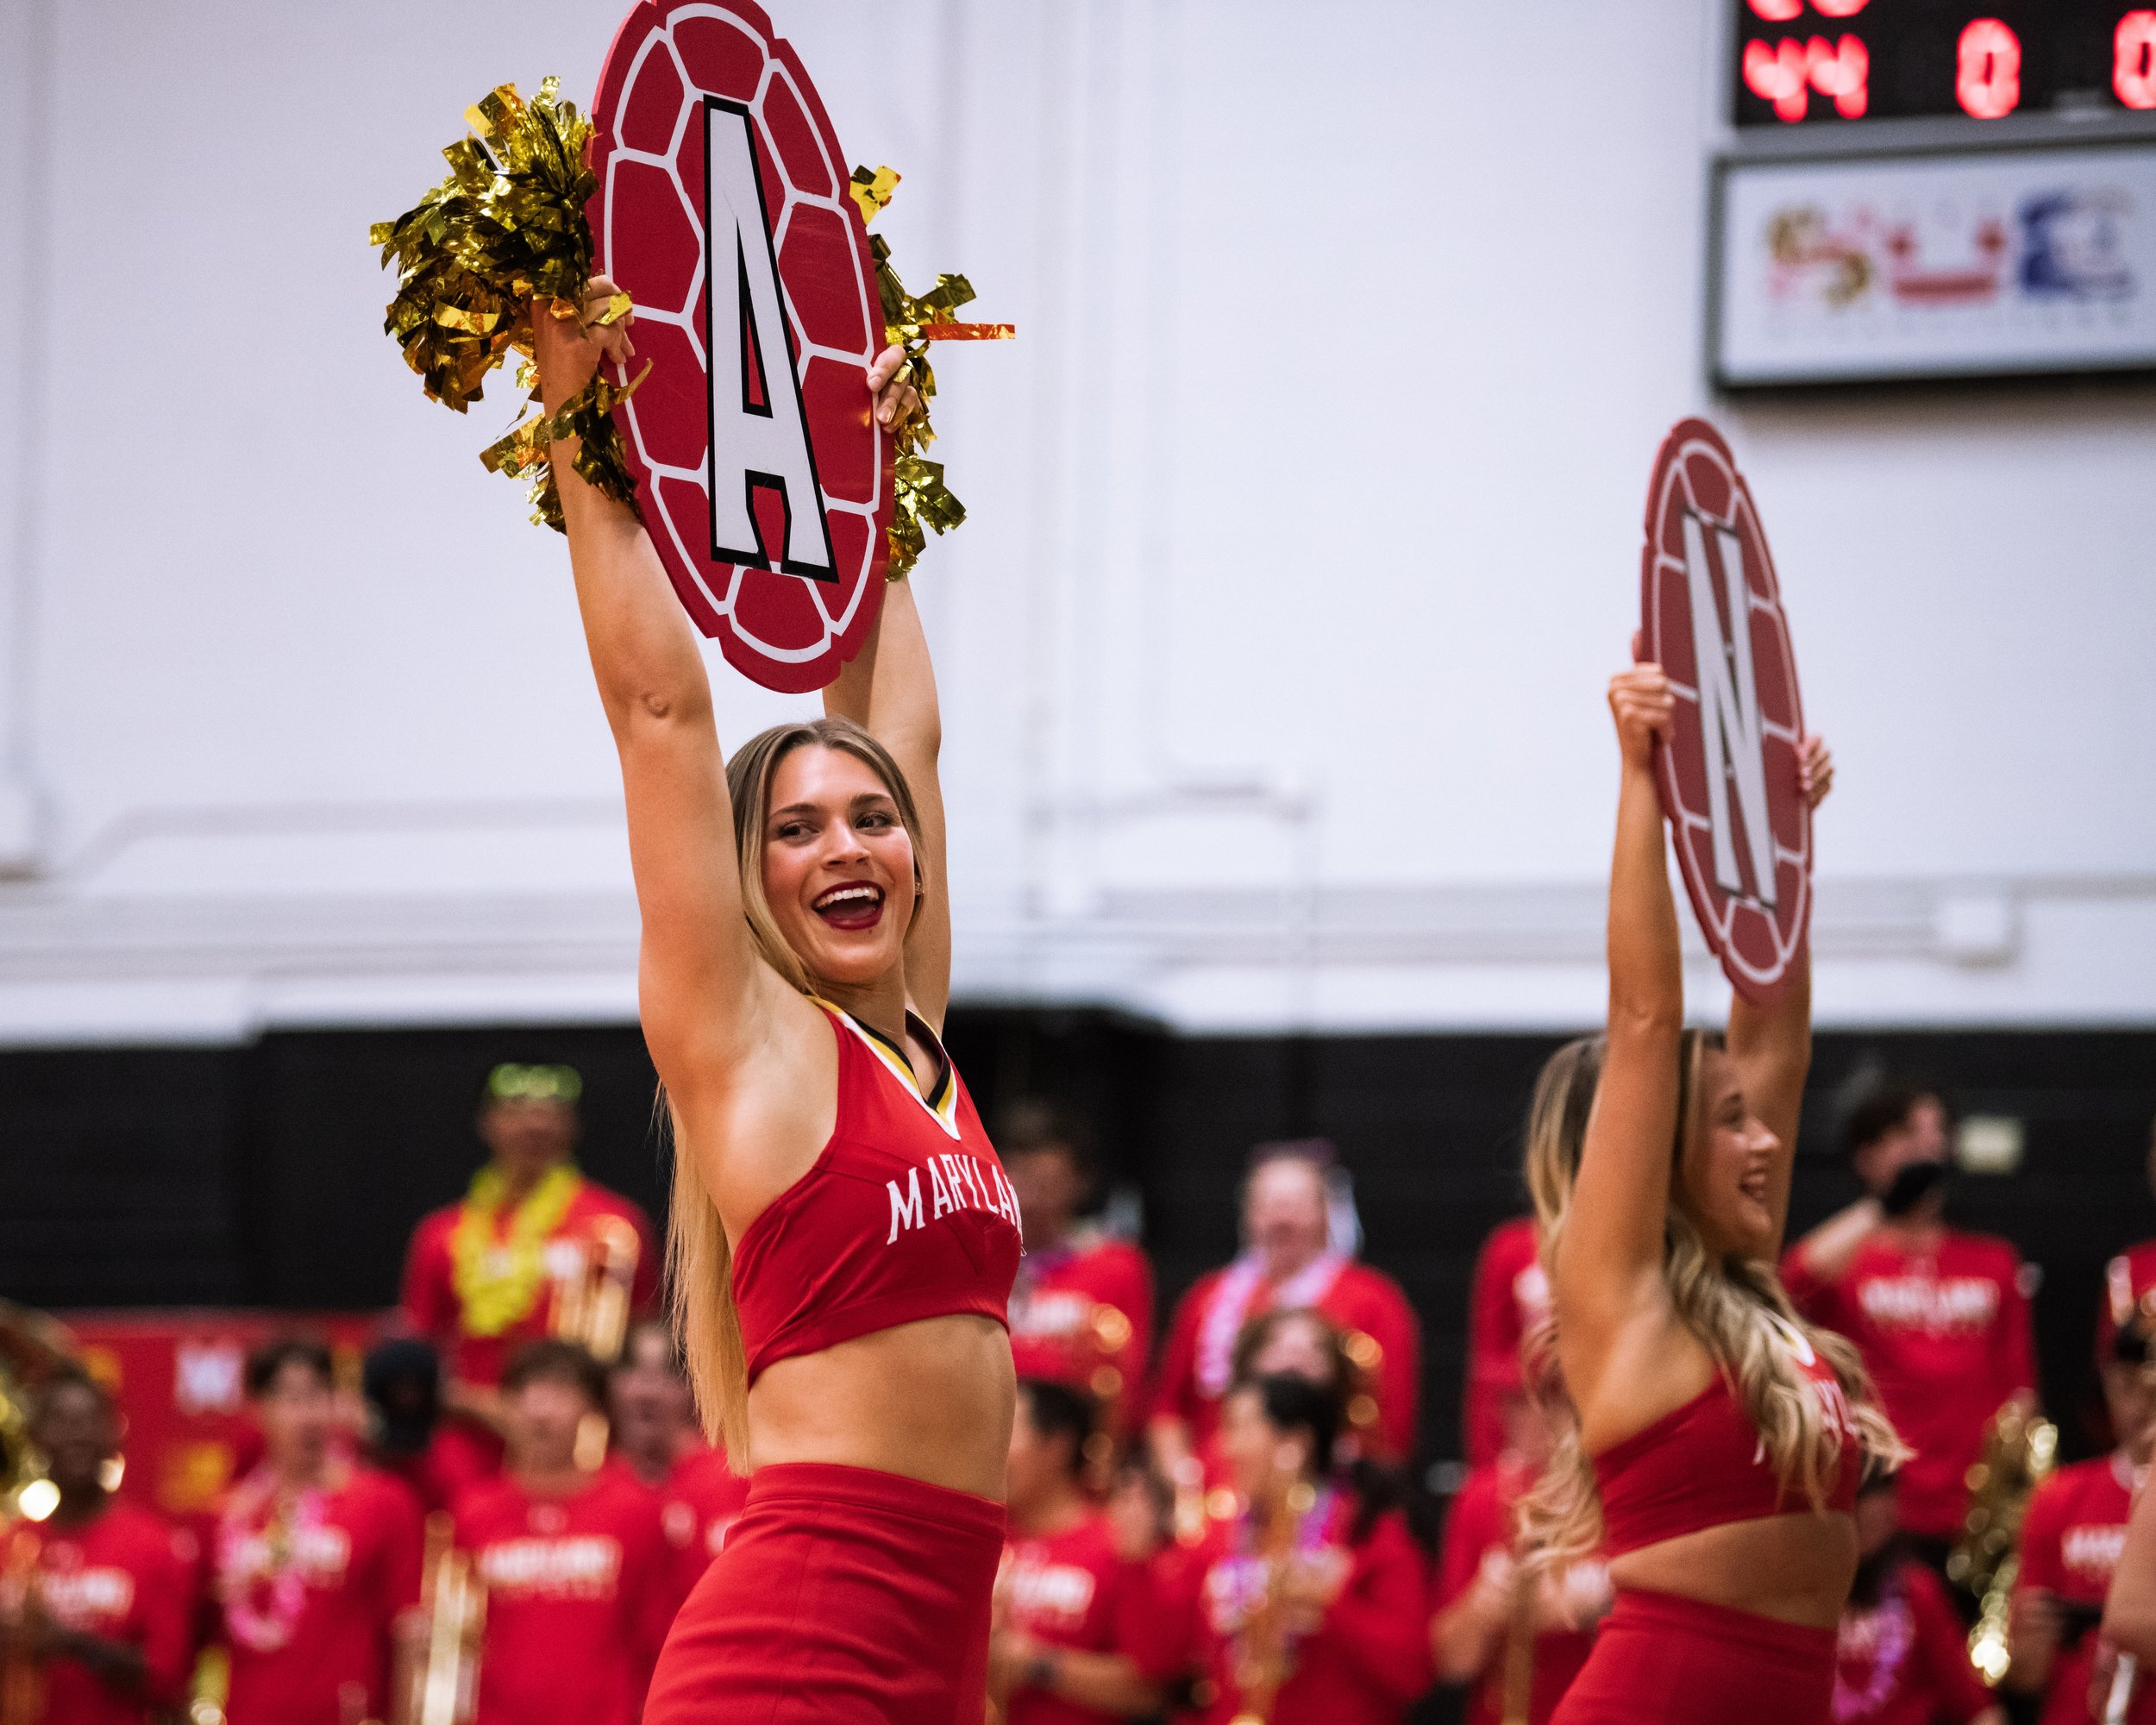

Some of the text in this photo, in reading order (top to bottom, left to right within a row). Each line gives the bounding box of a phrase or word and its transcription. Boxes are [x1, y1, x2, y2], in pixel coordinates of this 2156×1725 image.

[1742, 34, 1870, 122] 44
[1956, 17, 2021, 119] 0
[703, 93, 840, 584] A
[1681, 502, 1778, 913] N
